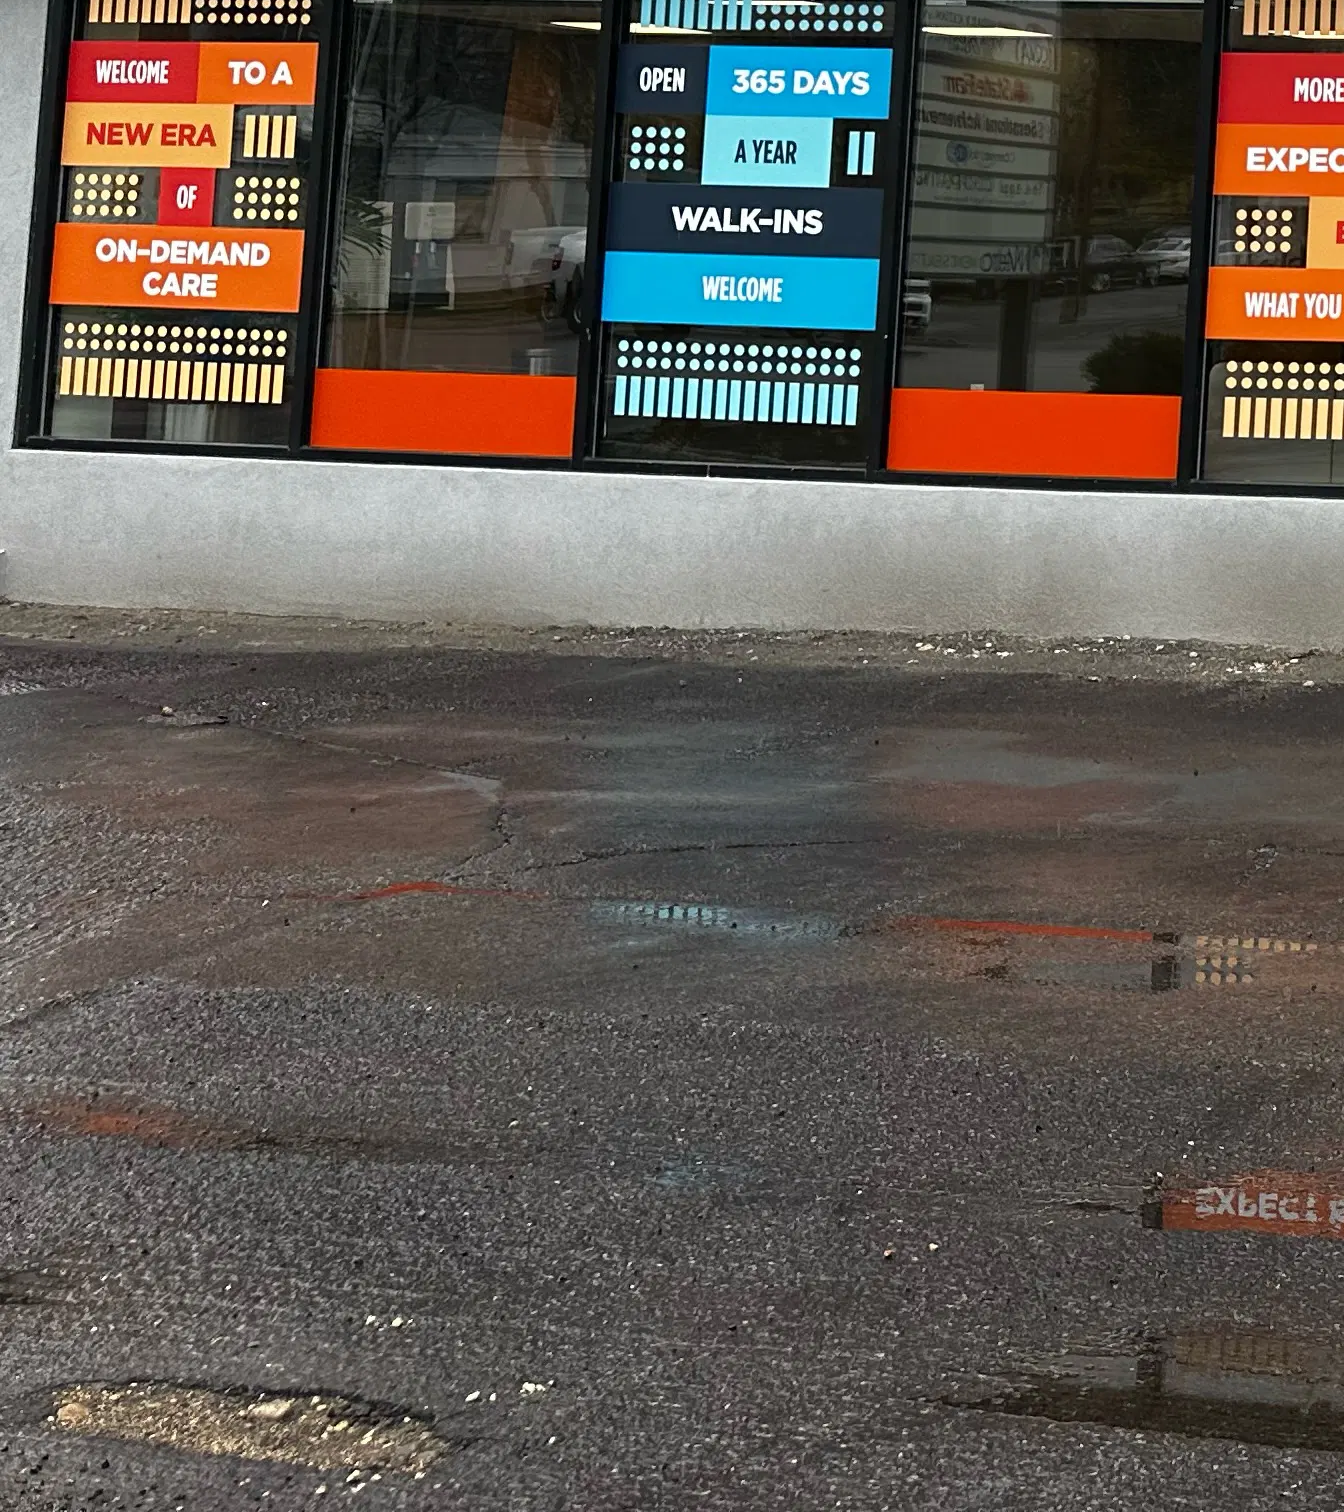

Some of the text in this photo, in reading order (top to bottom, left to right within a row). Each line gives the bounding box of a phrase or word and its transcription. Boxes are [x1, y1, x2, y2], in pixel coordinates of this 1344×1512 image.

[96, 59, 293, 85] WELCOME TO A
[639, 67, 870, 95] OPEN 365 DAYS
[1294, 78, 1344, 102] MORE
[87, 123, 216, 147] NEW ERA
[734, 140, 797, 165] A YEAR
[177, 186, 197, 209] OF
[672, 206, 824, 235] WALK-INS
[96, 238, 270, 267] ON-DEMAND
[142, 272, 217, 297] CARE
[702, 277, 783, 303] WELCOME
[1245, 293, 1299, 318] WHAT
[1303, 294, 1342, 319] YOU
